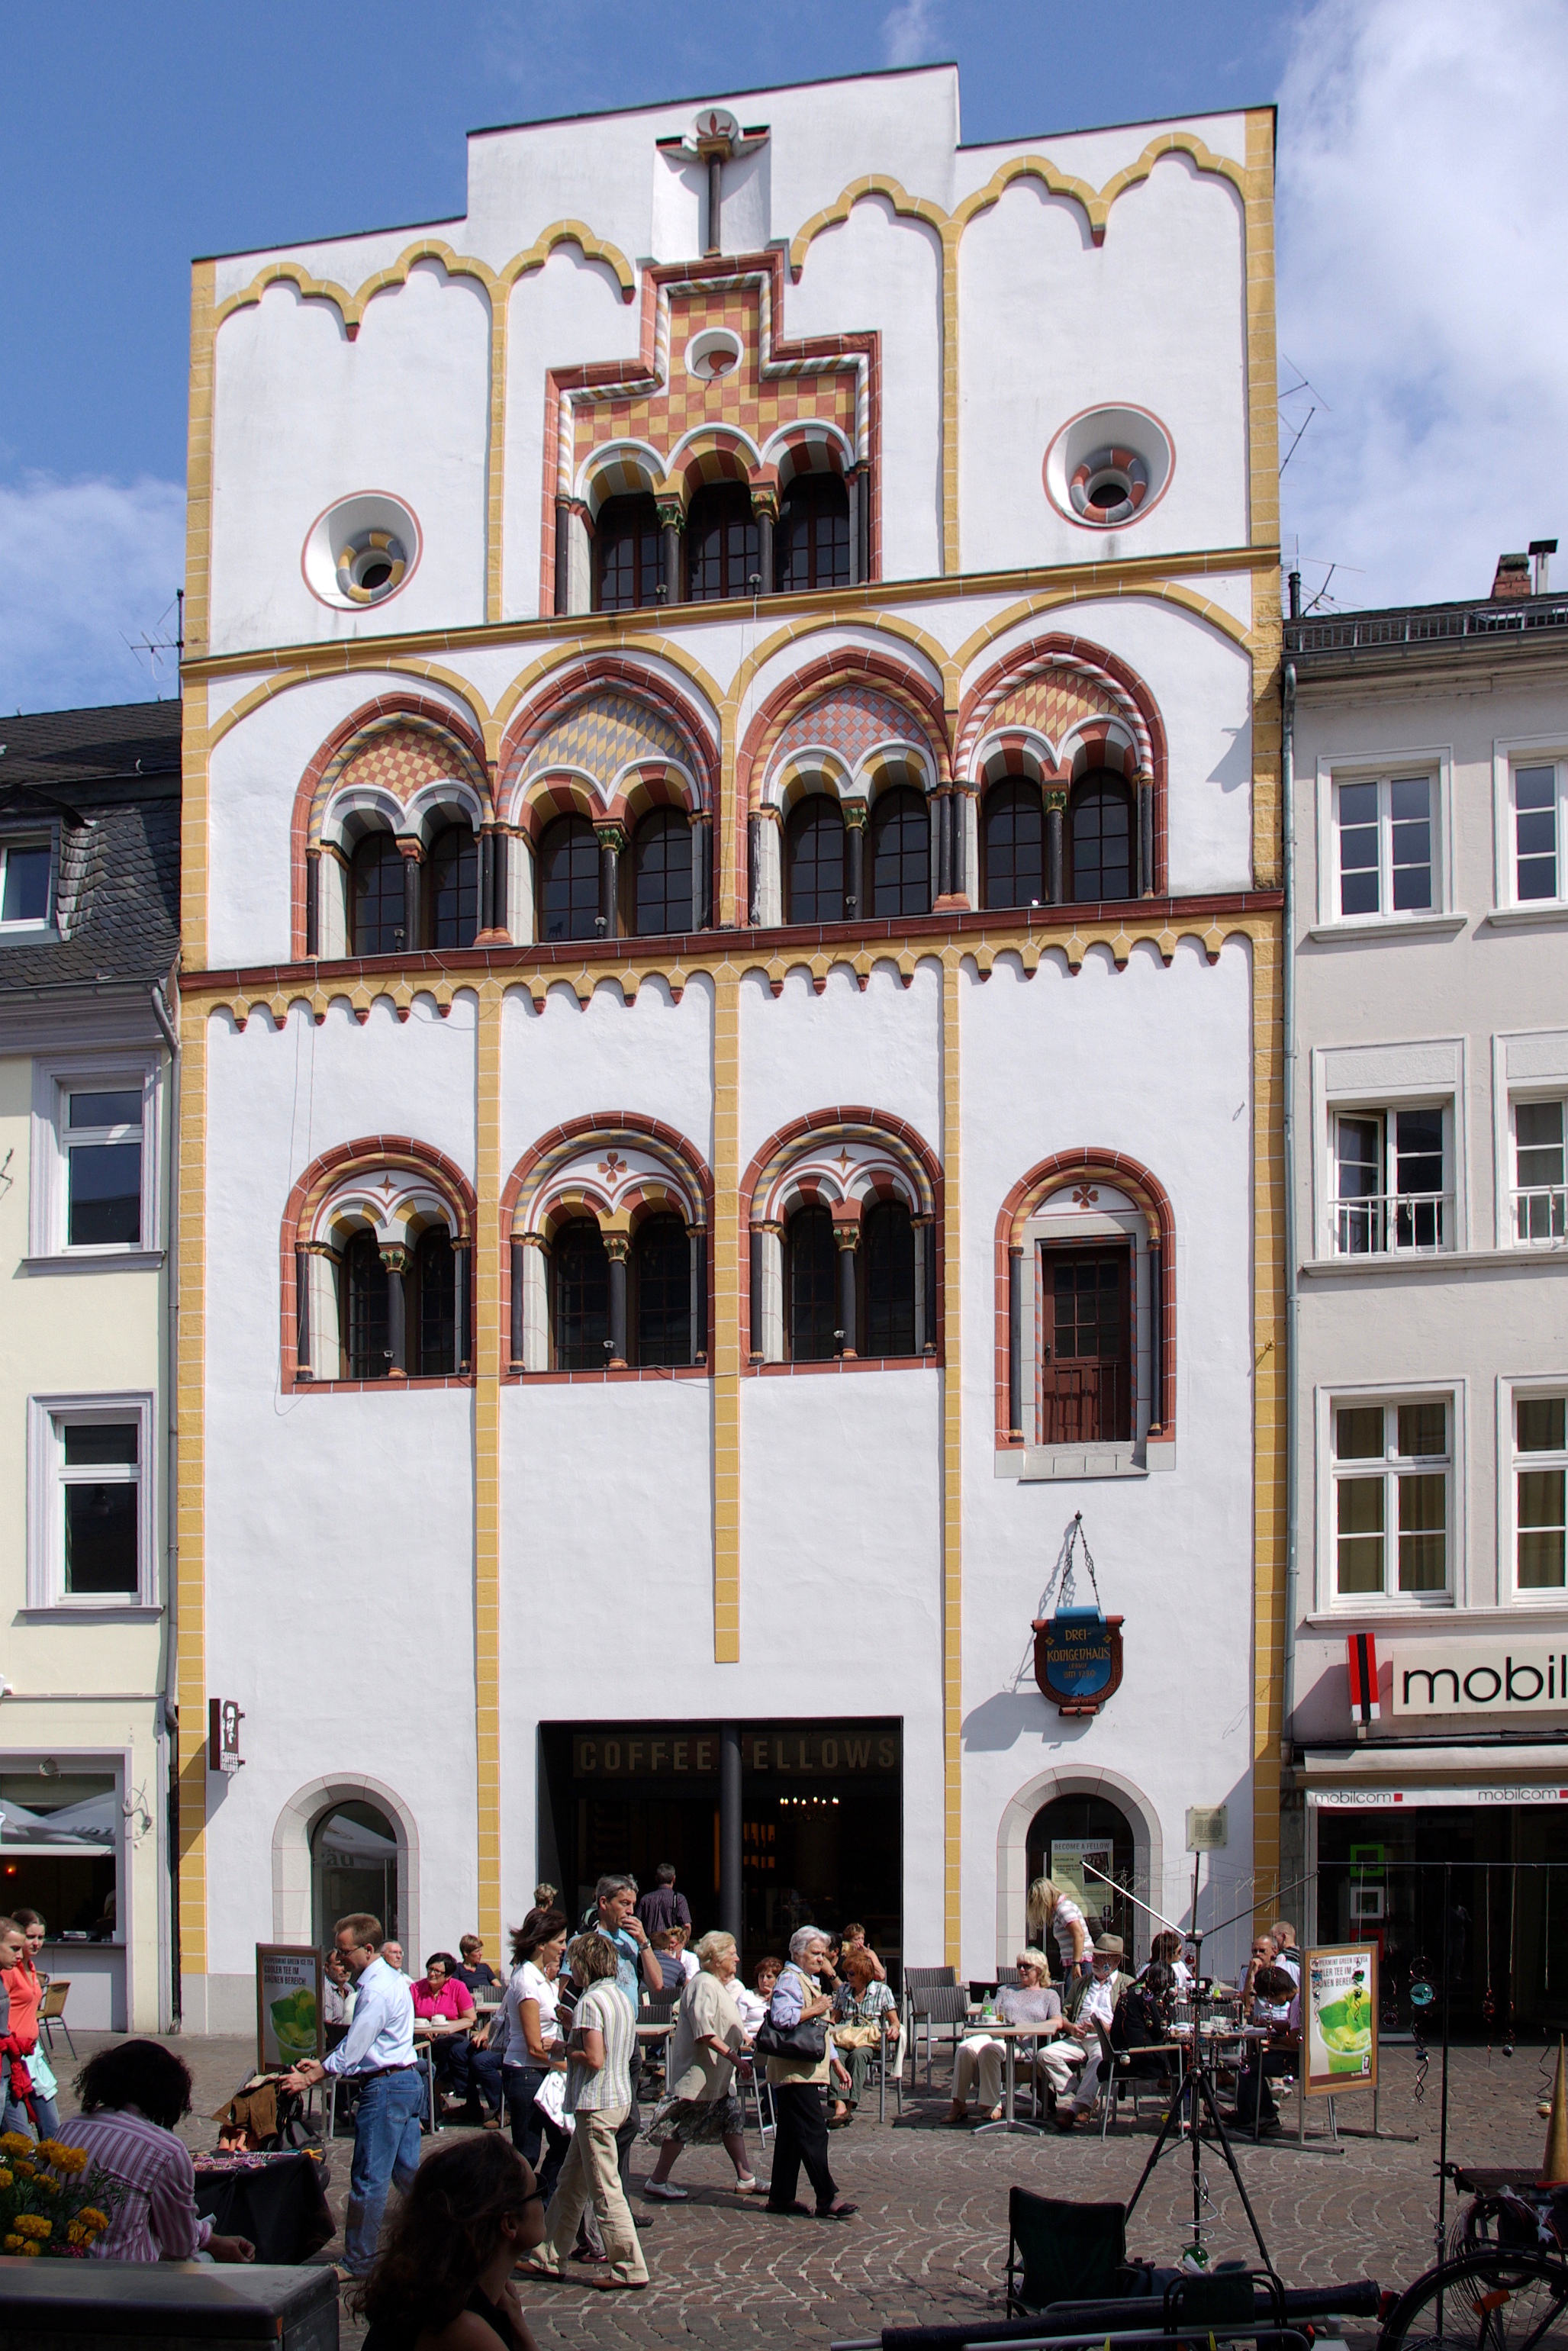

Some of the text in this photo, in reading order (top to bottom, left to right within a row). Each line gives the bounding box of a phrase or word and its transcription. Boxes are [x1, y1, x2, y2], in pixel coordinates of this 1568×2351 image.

[1065, 1628, 1092, 1641] DREI-
[580, 1737, 896, 1771] COFFEE ELLOWS
[1315, 1791, 1392, 1804] mobilcom
[1478, 1788, 1557, 1802] mobilcom
[1338, 1956, 1353, 1965] GREEN
[1334, 1966, 1344, 1976] TEE
